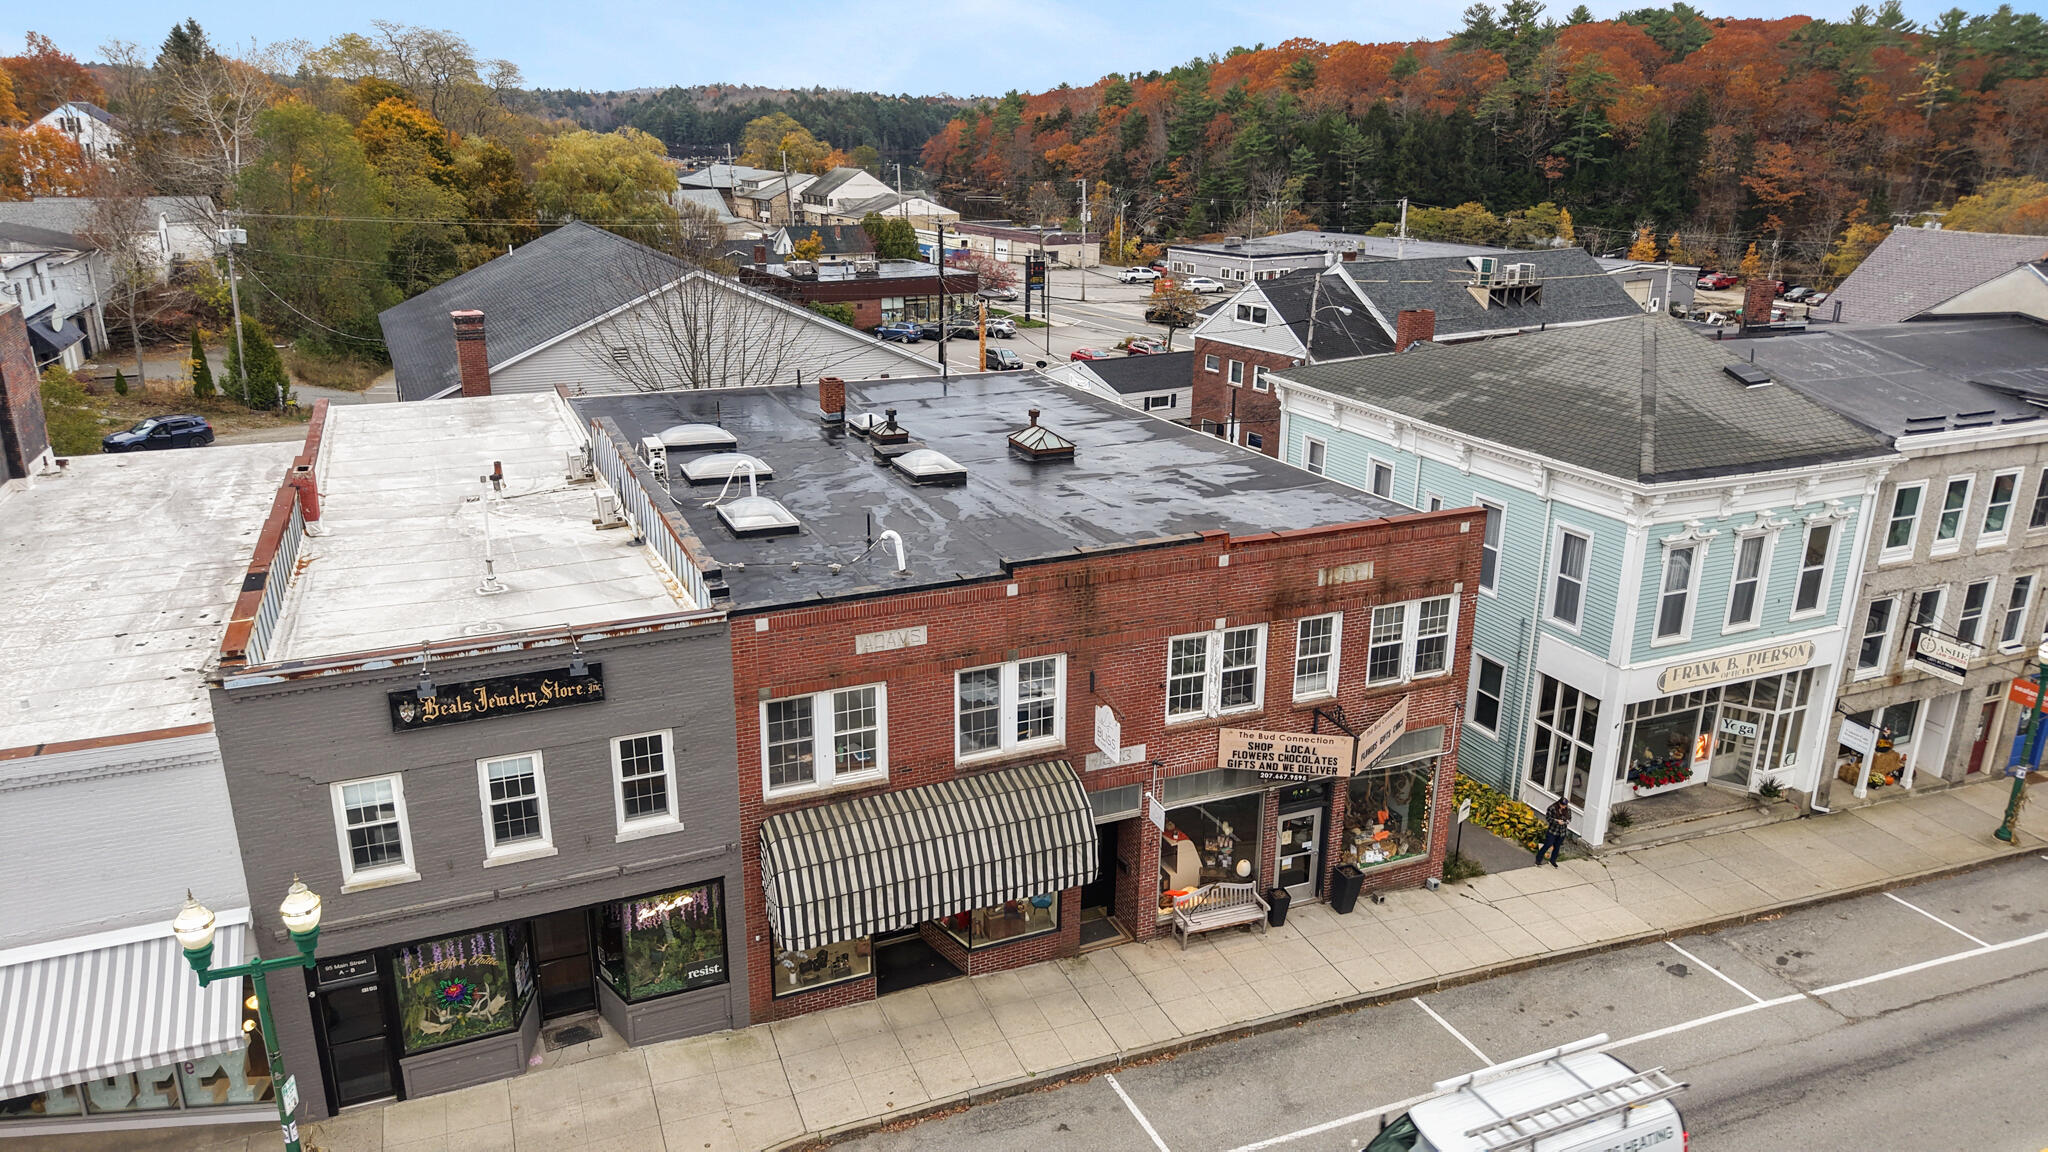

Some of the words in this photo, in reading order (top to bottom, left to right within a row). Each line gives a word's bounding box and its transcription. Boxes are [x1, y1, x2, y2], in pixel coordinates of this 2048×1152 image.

[1938, 645, 1968, 661] ASHE
[1672, 663, 1720, 681] FRANK
[1747, 644, 1807, 668] PIERSON
[420, 696, 472, 722] Beals
[473, 685, 538, 713] Jewelry
[1723, 719, 1754, 736] Yoga
[1239, 731, 1255, 739] The
[1258, 732, 1276, 741] Bud
[1279, 734, 1335, 745] Connection
[1247, 741, 1274, 752] SHOP
[1284, 744, 1317, 756] LOCAL
[1232, 750, 1275, 761] FLOWERS
[1278, 753, 1338, 766] CHOCOLATES
[1227, 759, 1256, 769] GIFTS
[1258, 762, 1279, 771] AND
[1282, 763, 1295, 772] WE
[1298, 764, 1338, 775] DELIVER
[349, 959, 367, 967] Street
[687, 963, 722, 980] resist.
[1623, 1126, 1674, 1152] HEATING
